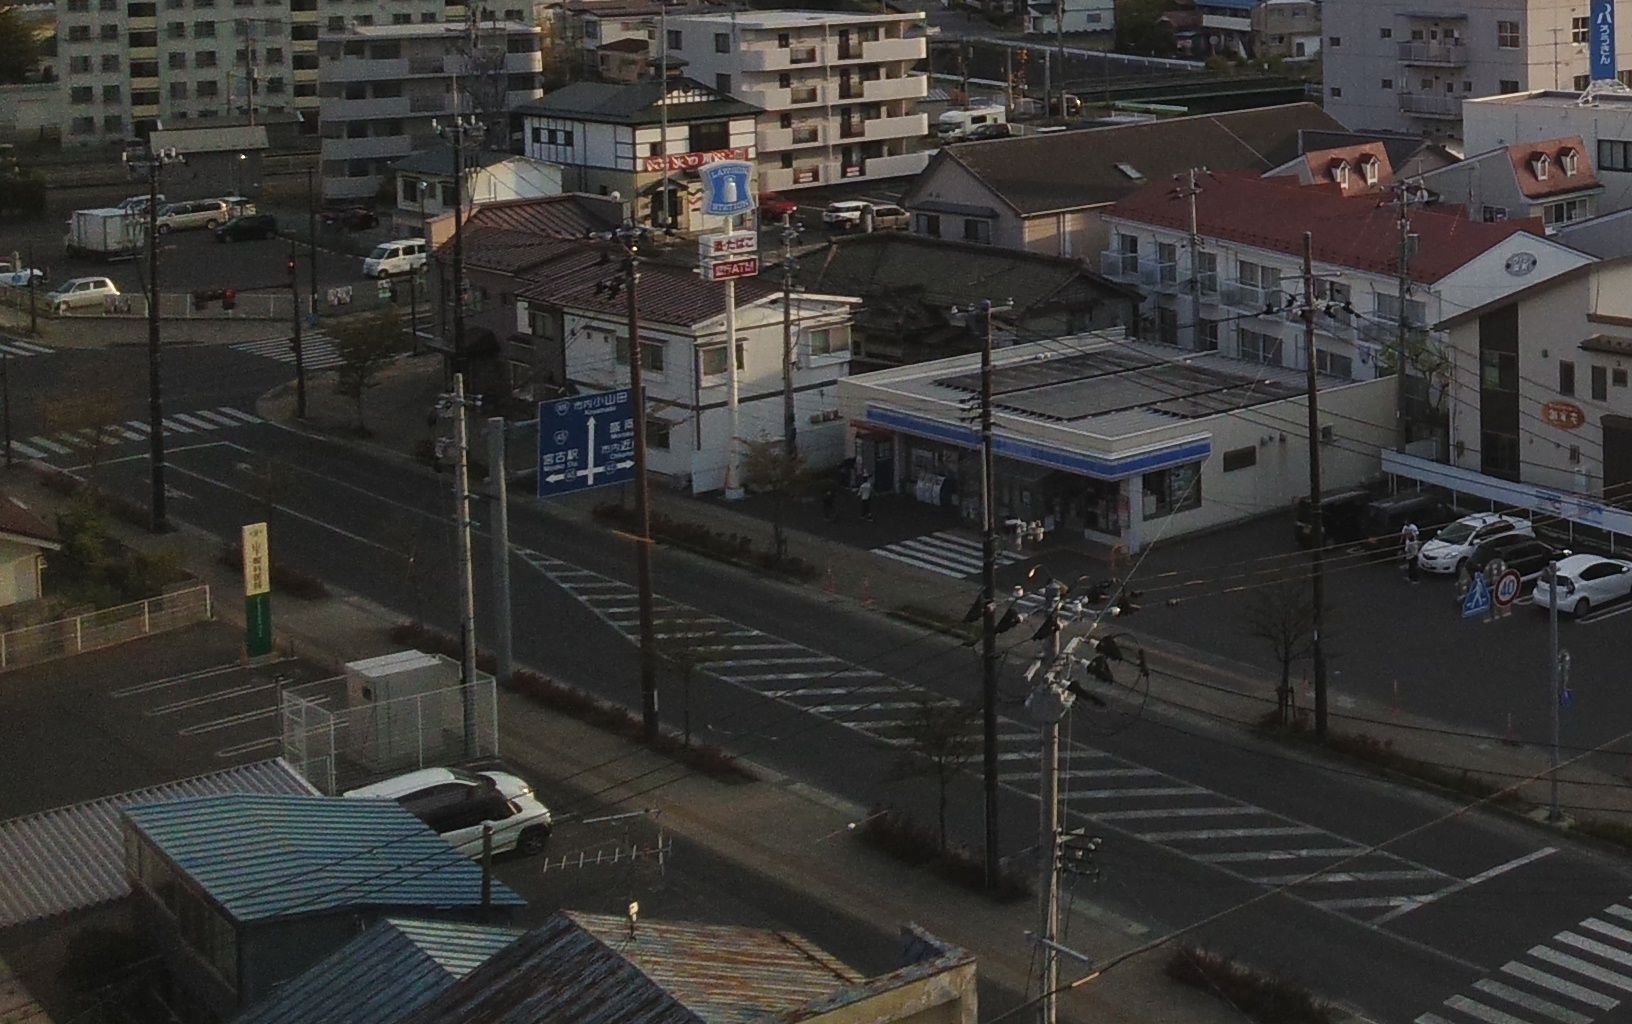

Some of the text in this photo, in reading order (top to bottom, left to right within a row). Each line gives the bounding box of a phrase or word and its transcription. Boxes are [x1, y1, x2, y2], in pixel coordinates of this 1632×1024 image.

[1600, 24, 1611, 65] ろうきん
[712, 166, 750, 180] LAWSON
[712, 199, 750, 212] STATION
[574, 392, 627, 409] 市内小山田
[601, 439, 635, 454] 市内近
[543, 449, 578, 464] 宮古駅
[1501, 579, 1515, 596] 40
